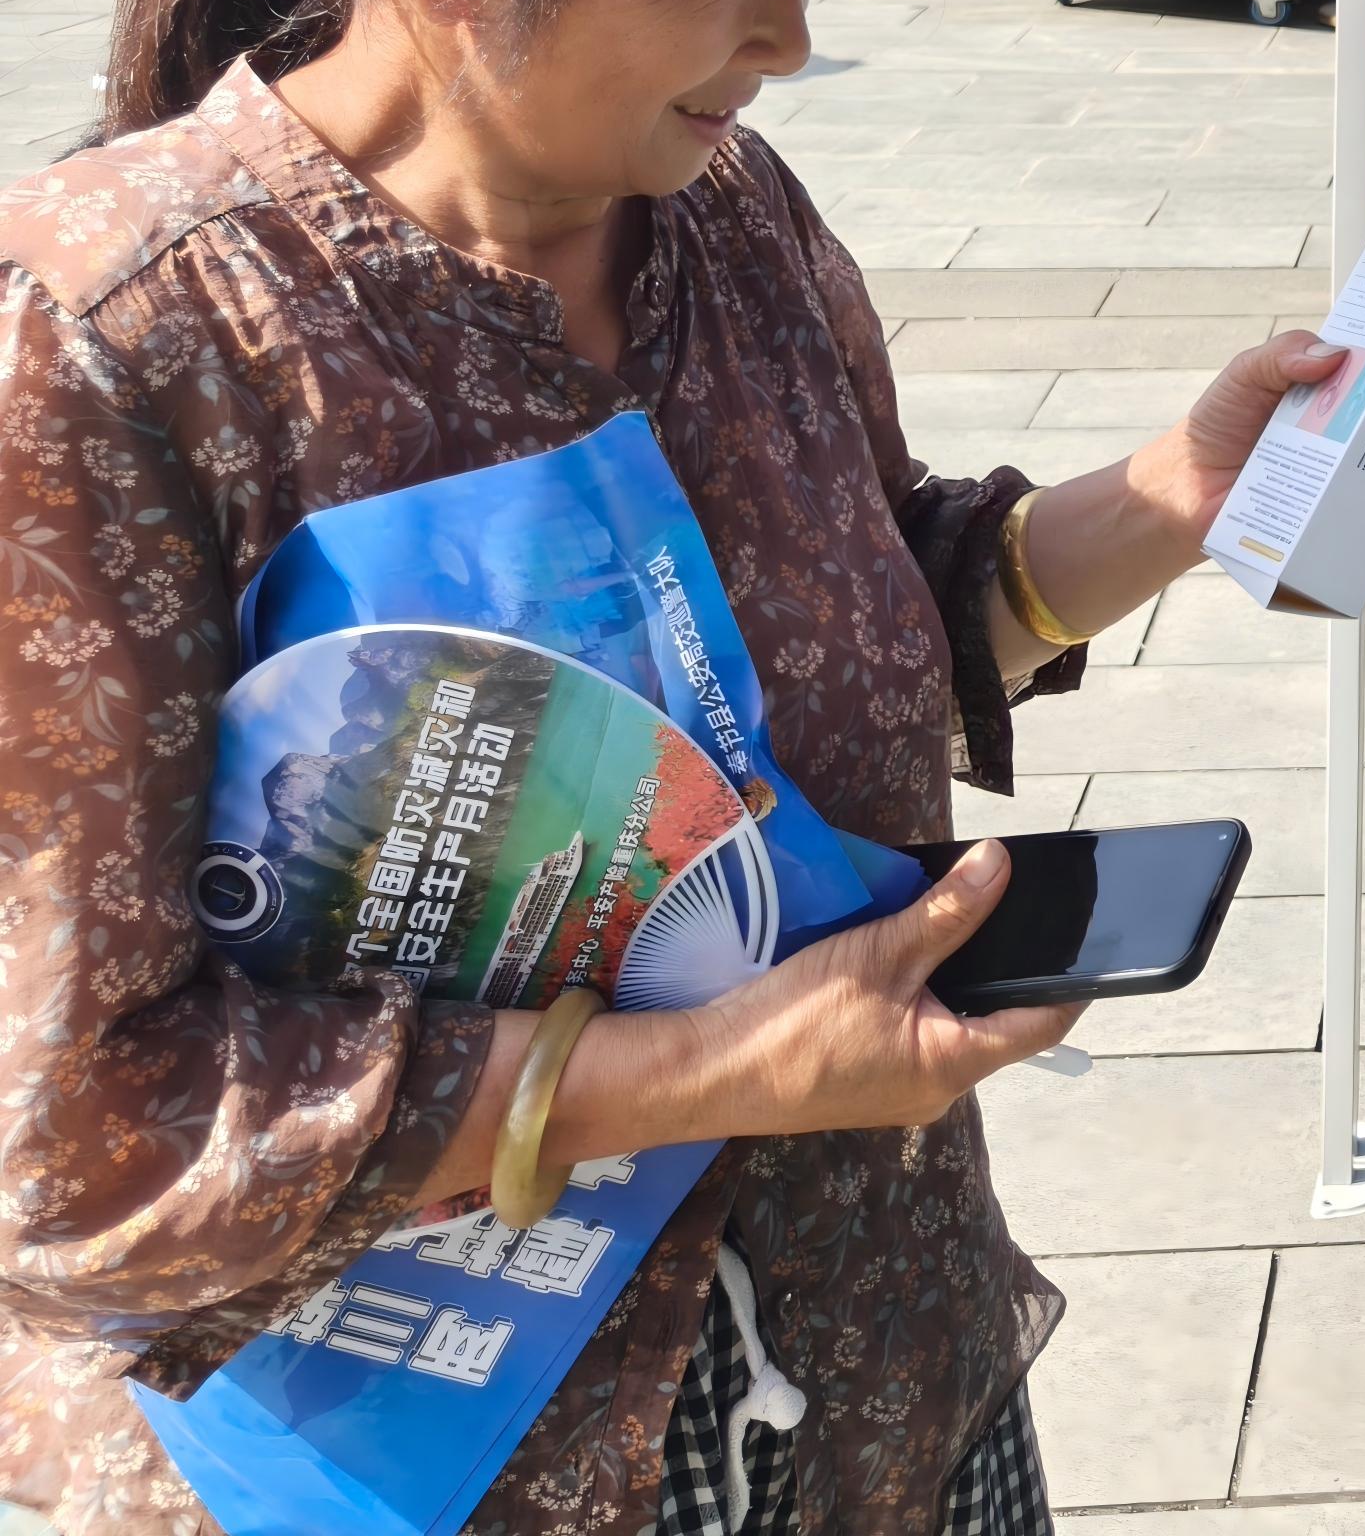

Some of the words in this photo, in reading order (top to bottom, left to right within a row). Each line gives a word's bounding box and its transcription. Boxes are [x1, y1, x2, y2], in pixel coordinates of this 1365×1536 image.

[645, 544, 750, 775] 奉节县公安局交巡警大队
[346, 679, 477, 978] 个全国防灾减灾和
[587, 776, 662, 930] 平安产险重庆分公司
[373, 1214, 615, 1298] 摩托
